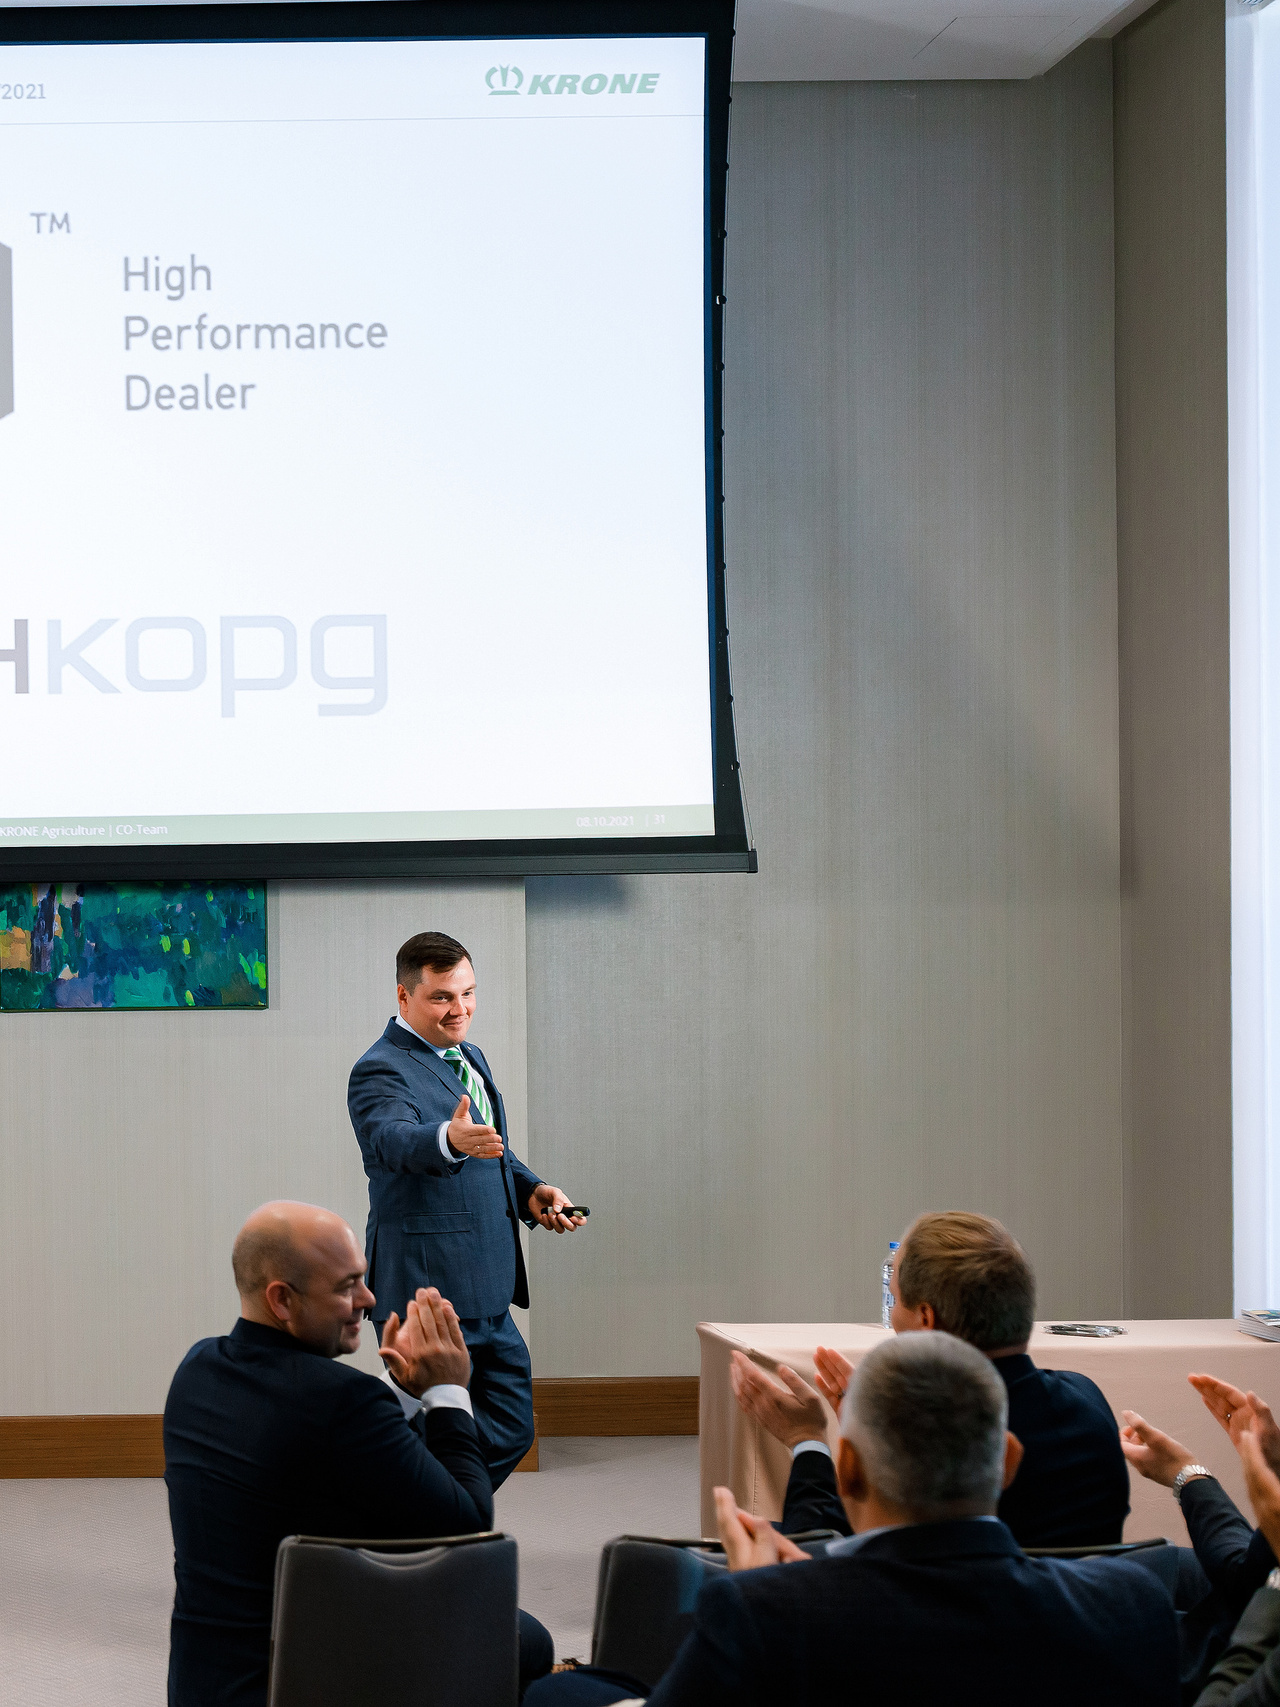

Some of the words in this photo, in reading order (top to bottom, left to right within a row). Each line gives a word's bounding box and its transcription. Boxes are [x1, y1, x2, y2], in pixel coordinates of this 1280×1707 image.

[528, 73, 661, 94] KRONE
[124, 255, 211, 301] High
[125, 313, 388, 351] Performance
[126, 373, 256, 411] Dealer
[0, 827, 38, 836] KRONE
[41, 825, 105, 839] Agriculture
[116, 825, 168, 835] CO-Team
